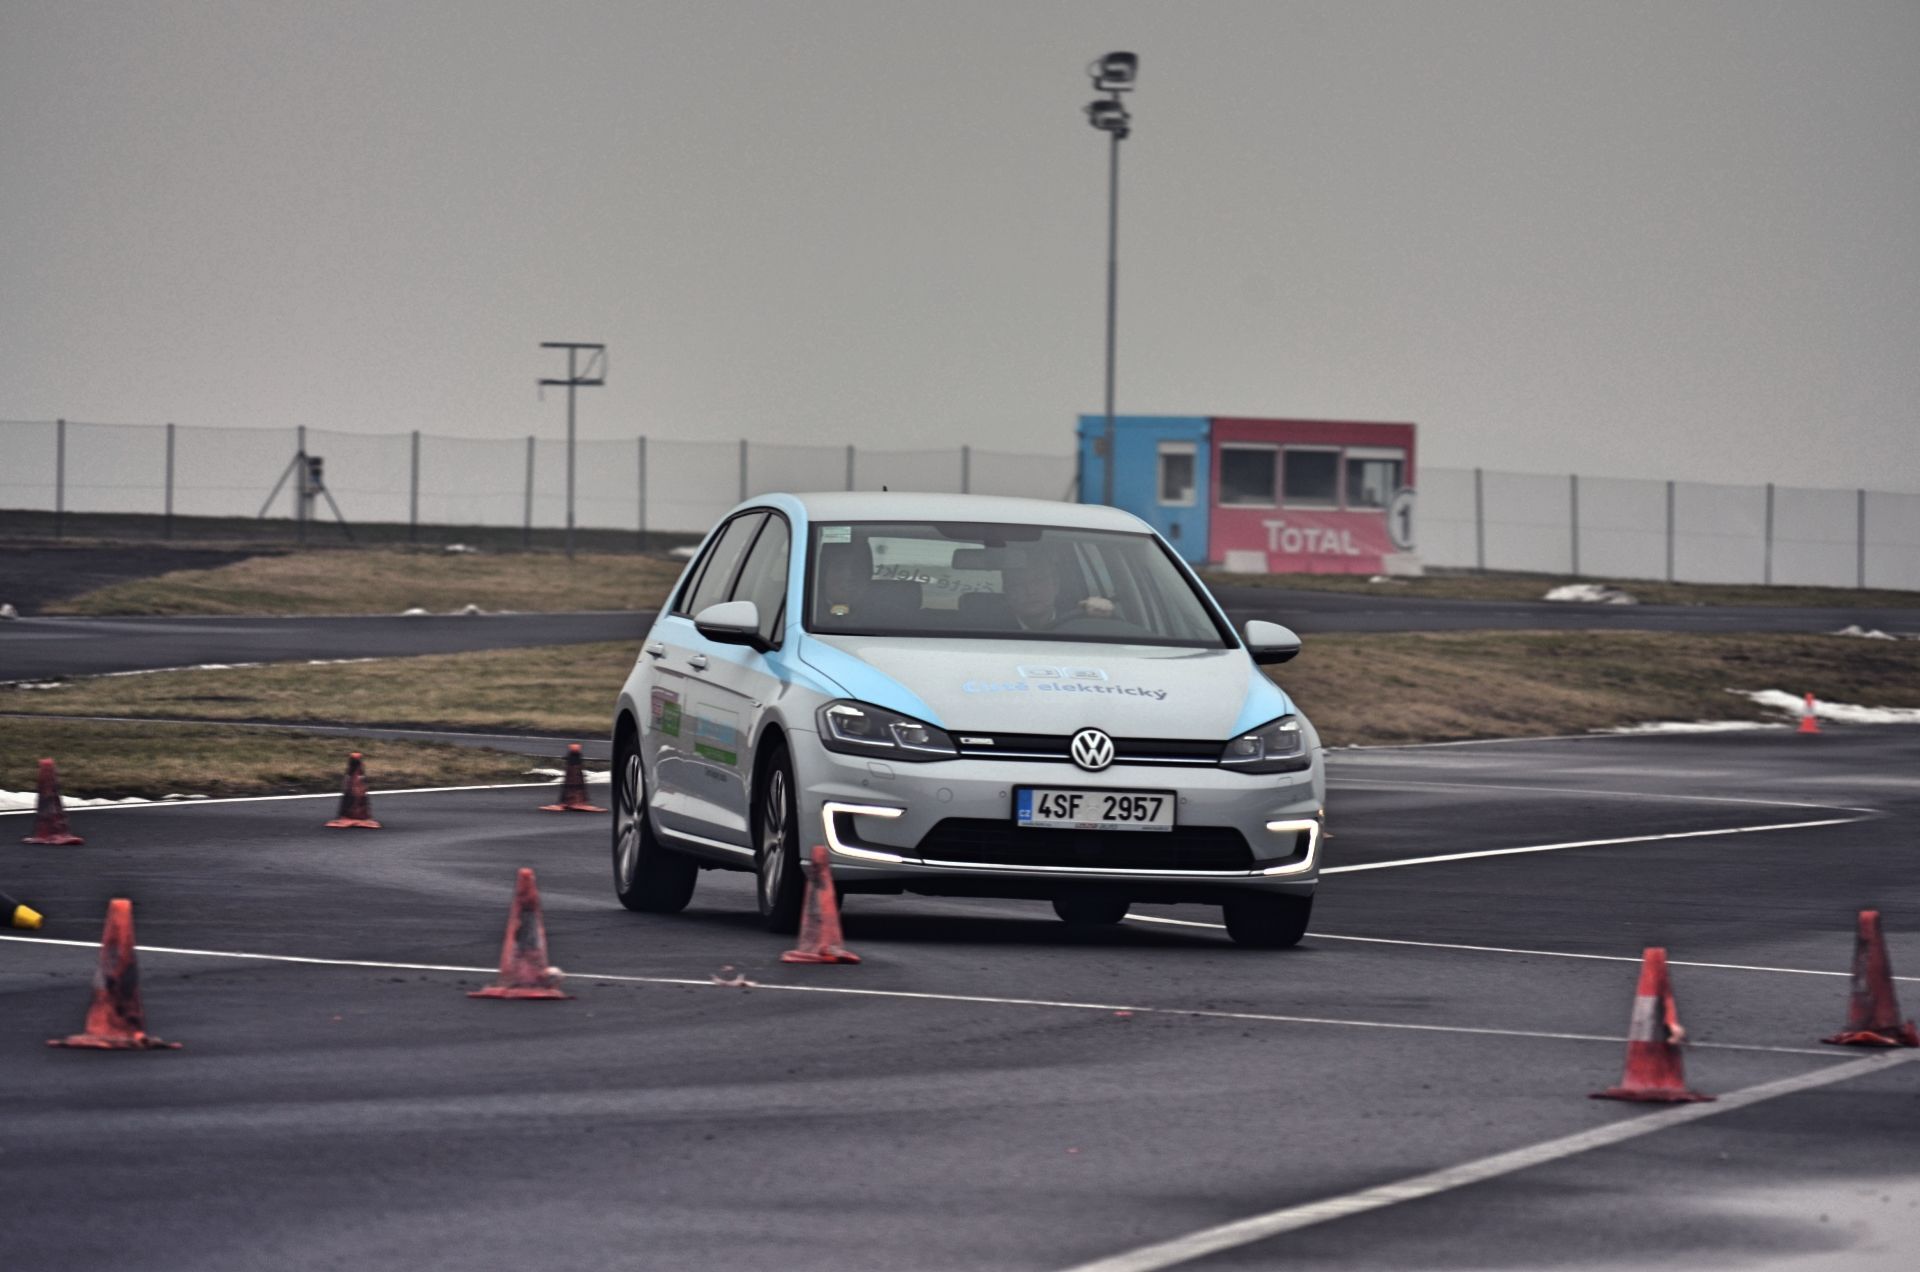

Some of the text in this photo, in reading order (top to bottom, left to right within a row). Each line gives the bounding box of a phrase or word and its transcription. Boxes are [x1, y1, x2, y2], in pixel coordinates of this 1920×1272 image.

[1263, 519, 1360, 556] TOTAL
[1038, 682, 1168, 700] elektrický
[1037, 793, 1164, 823] 4SF 2957
